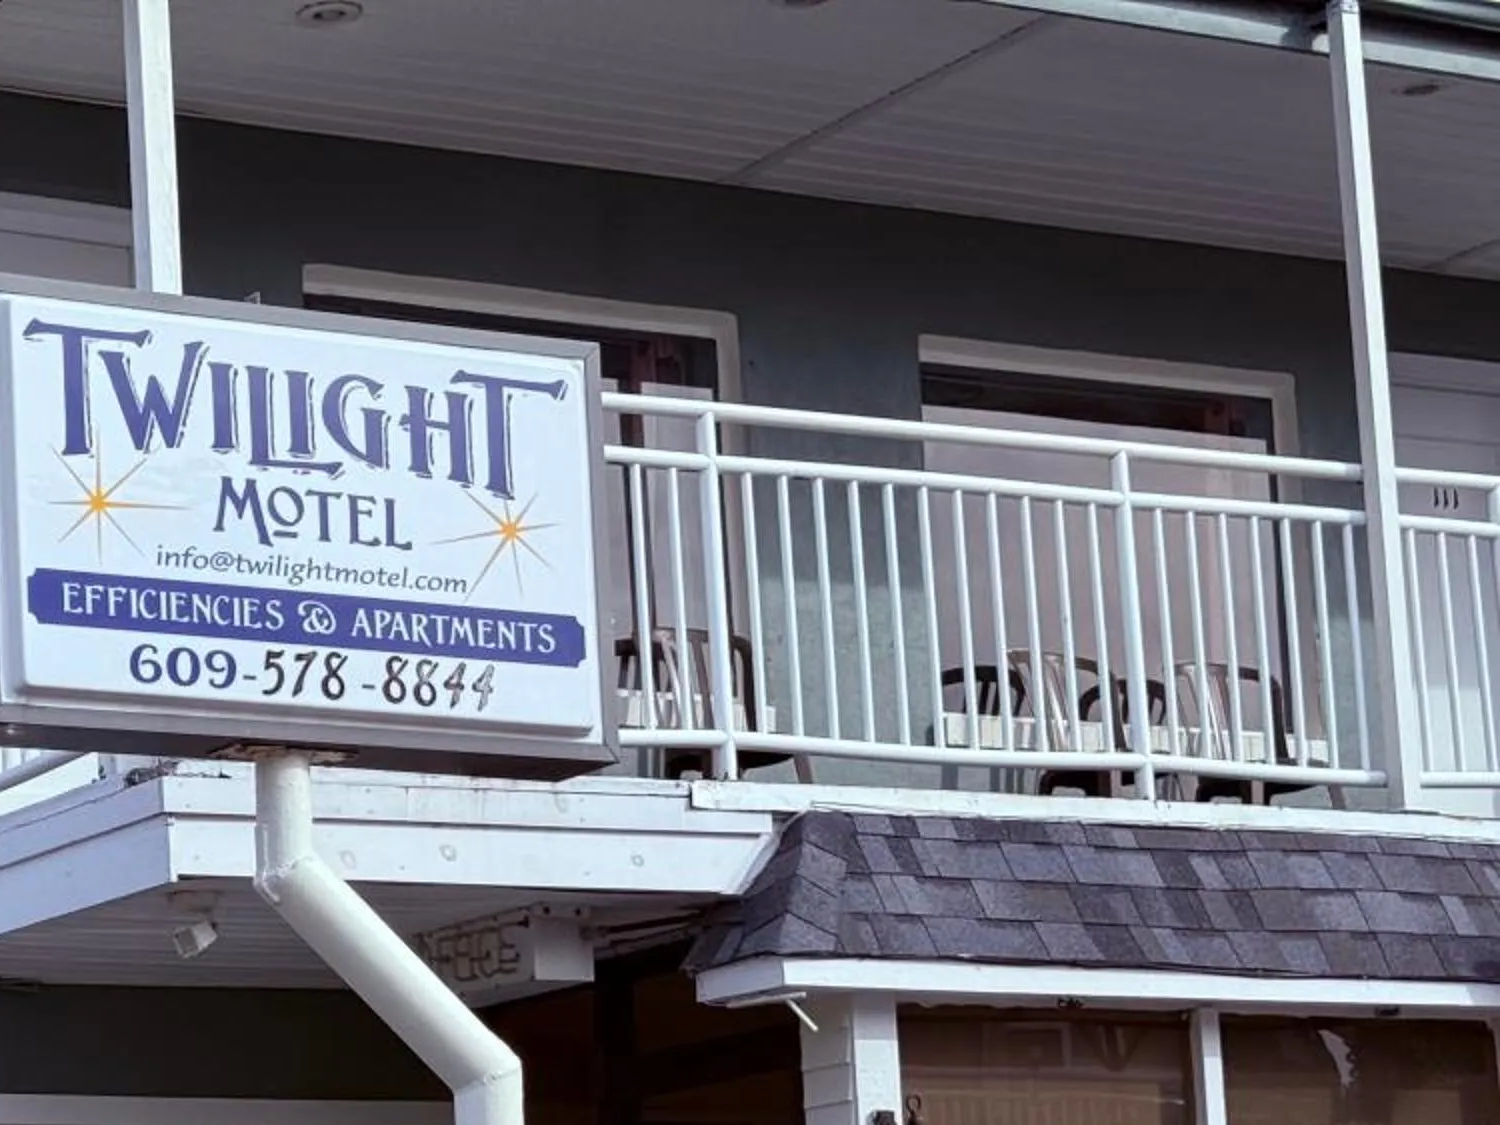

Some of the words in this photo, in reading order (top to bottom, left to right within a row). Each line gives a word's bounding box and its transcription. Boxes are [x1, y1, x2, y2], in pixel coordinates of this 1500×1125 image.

[22, 317, 568, 500] TWILIGHT
[212, 475, 414, 552] MOTEL
[155, 544, 468, 594] info@twilightmotel.com
[61, 581, 285, 631] EFFICIENCIES
[351, 608, 557, 653] APARTMENTS
